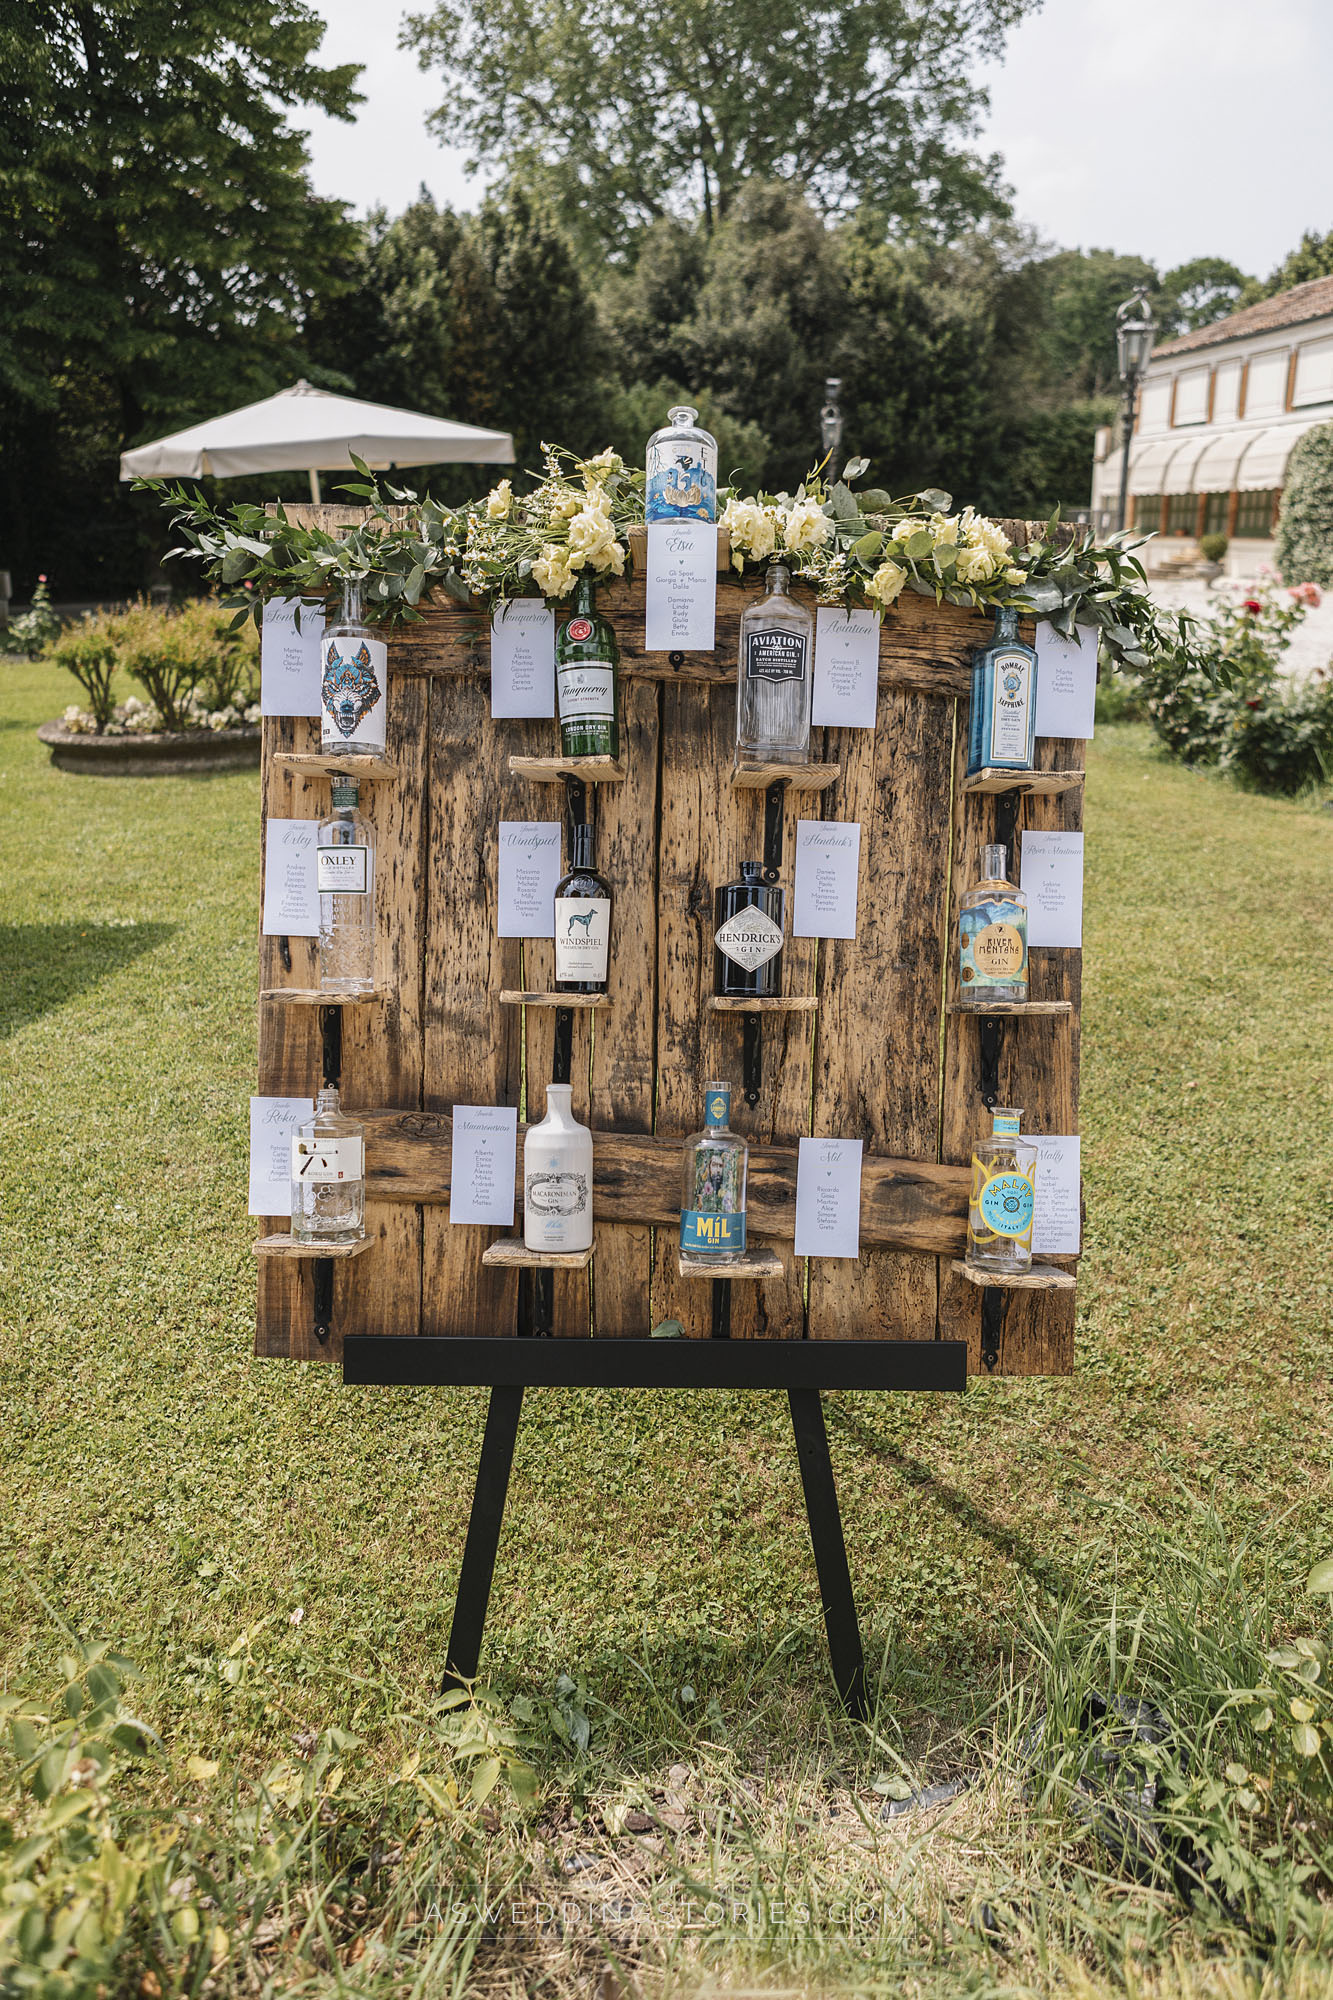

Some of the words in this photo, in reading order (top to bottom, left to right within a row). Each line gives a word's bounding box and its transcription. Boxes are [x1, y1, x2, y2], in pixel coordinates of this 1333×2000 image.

[665, 537, 695, 553] Etsu
[678, 570, 694, 578] Sposi
[655, 577, 677, 585] Giorgia
[672, 610, 689, 618] Rudy
[672, 623, 688, 631] Betty
[821, 620, 873, 635] Aviation
[752, 635, 802, 649] AVIATION
[759, 649, 785, 657] AMERICAN
[1000, 661, 1025, 674] BOMBAY
[561, 684, 609, 698] Tanqueray
[997, 696, 1026, 708] SAPPHIRE
[282, 831, 312, 849] Oxley
[502, 833, 559, 849] Windspiel
[803, 833, 853, 848] Hendrick's
[321, 856, 356, 866] OXLEY
[559, 937, 604, 947] WINDSPIEL
[720, 933, 781, 944] HENDRICK'S
[987, 938, 1013, 947] RIVER
[262, 1109, 297, 1124] Roku
[989, 1179, 1032, 1197] MALFY
